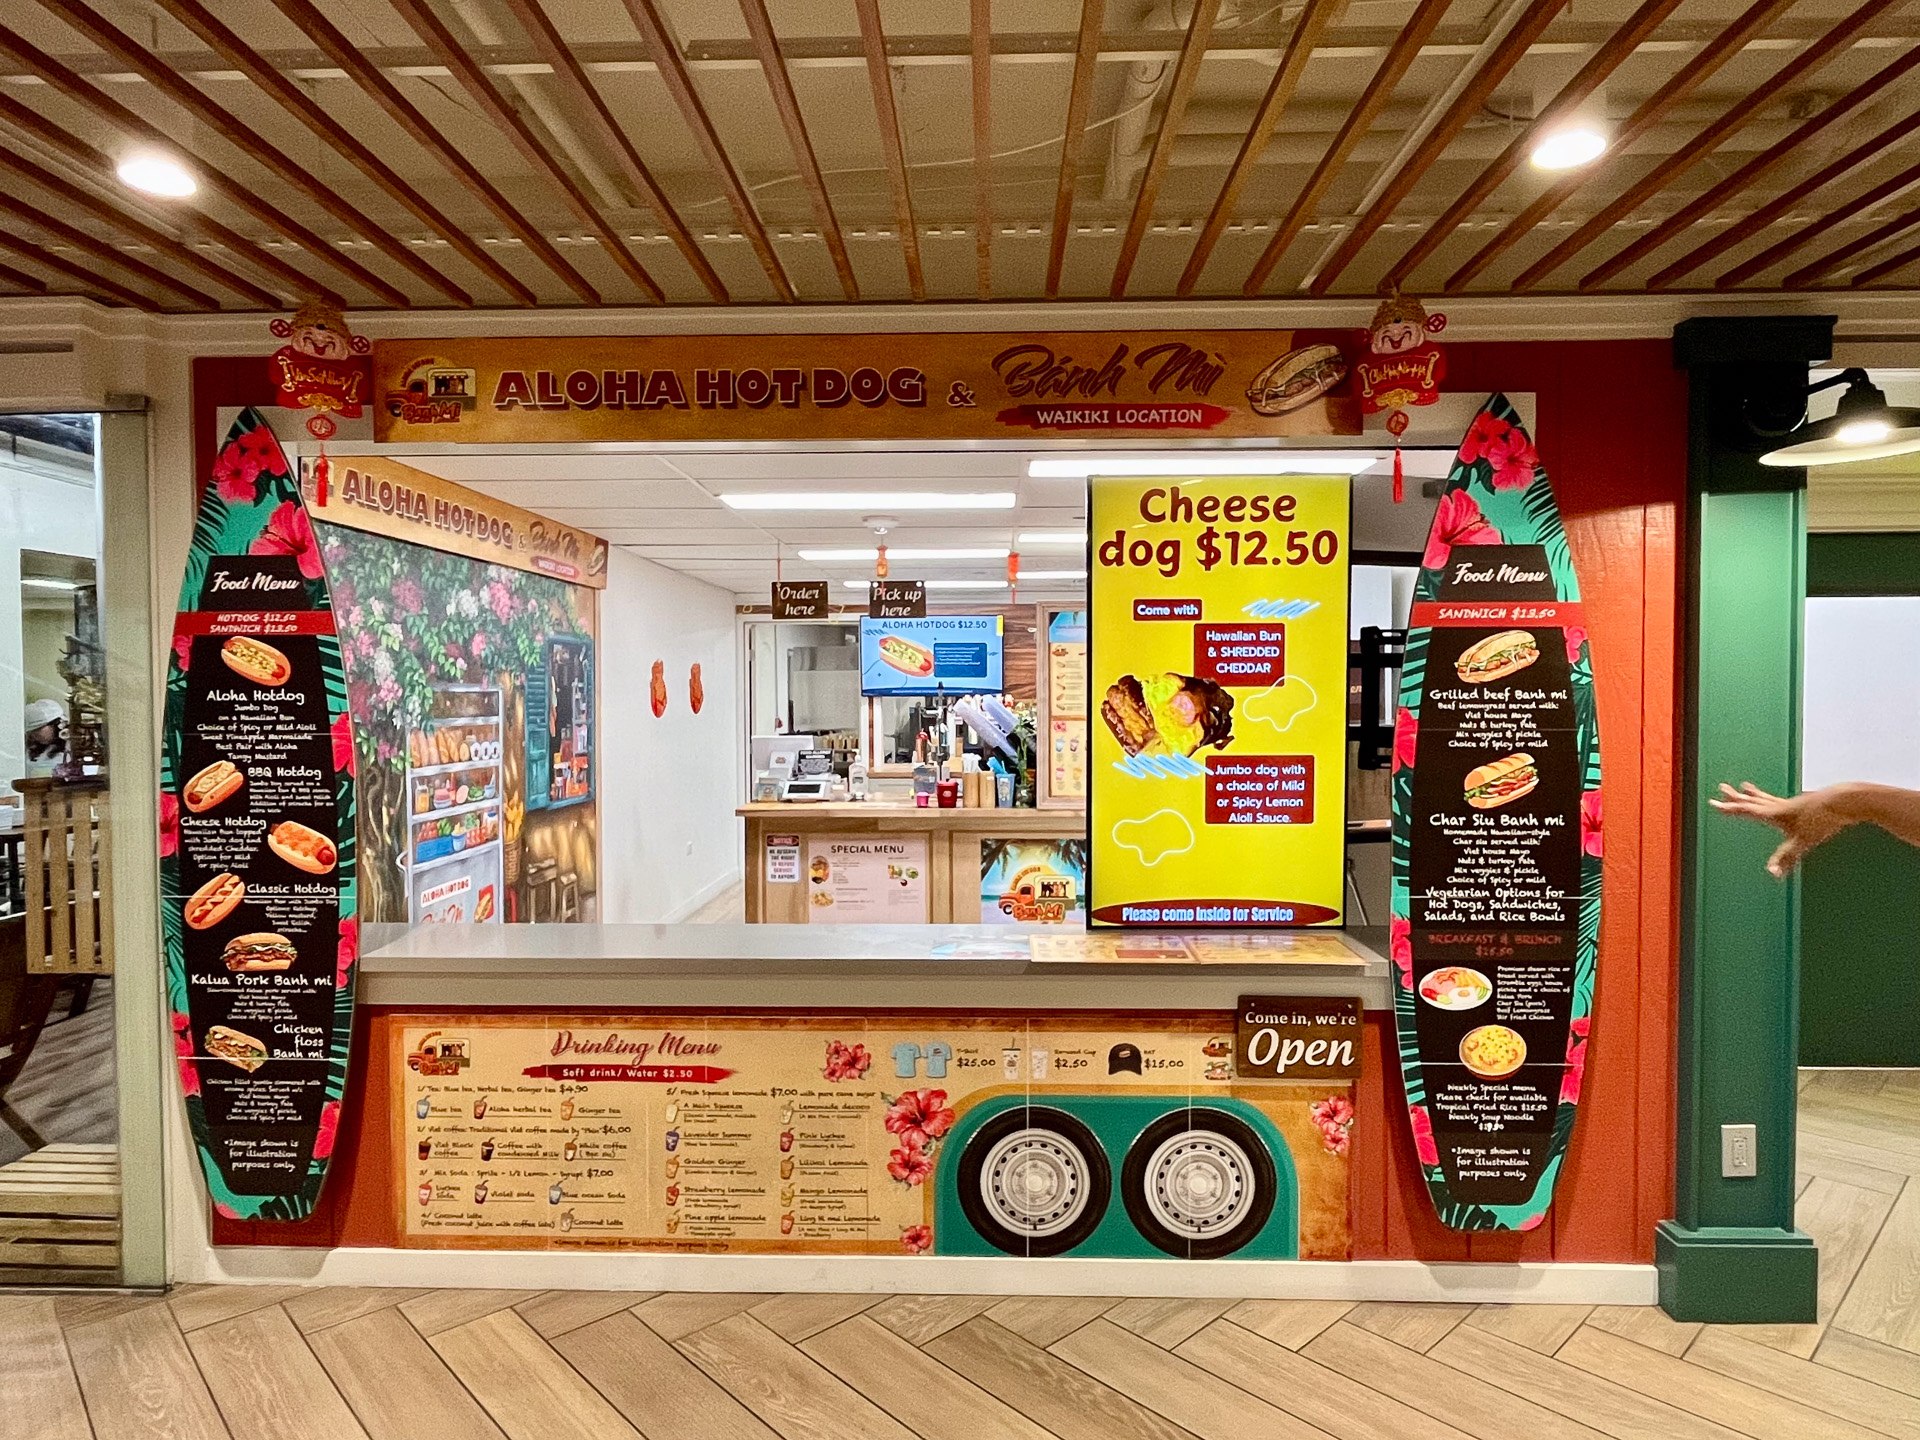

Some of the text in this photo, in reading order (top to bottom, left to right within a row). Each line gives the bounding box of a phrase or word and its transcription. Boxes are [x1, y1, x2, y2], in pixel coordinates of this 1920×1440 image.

[992, 343, 1129, 398] Bánh
[492, 368, 976, 410] ALOHA HOT DOG &
[1037, 410, 1202, 423] WAIKIKI LOCATION
[341, 468, 432, 527] ALOHA
[433, 497, 474, 538] HOT
[476, 514, 514, 549] DOG
[518, 534, 526, 548] &
[1140, 486, 1297, 523] Cheese
[1099, 526, 1338, 577] dog $12.50
[1452, 562, 1548, 584] Food Menu
[211, 571, 300, 592] Food Menu
[780, 587, 819, 600] Order
[873, 589, 921, 602] Pick up
[785, 604, 815, 615] here
[881, 605, 910, 616] here
[1137, 604, 1198, 615] Come with
[1439, 608, 1506, 619] SANDWICH
[217, 614, 260, 622] HOTDOG
[210, 625, 260, 633] SANDWICH
[958, 620, 987, 628] $12.50
[1206, 631, 1281, 641] Hawaiian Bun
[1208, 647, 1280, 657] & SHREDDED
[1216, 663, 1271, 673] CHEDDAR
[206, 689, 304, 705] Aloha Hotdog
[1430, 687, 1567, 700] Grilled beef Banh mi
[228, 723, 236, 732] of
[240, 723, 260, 734] Spicy
[1479, 740, 1489, 748] of
[248, 766, 322, 780] BBQ Hotdog
[1215, 764, 1305, 778] Jumbo dog with
[1216, 780, 1305, 791] a choice of Mild
[1216, 797, 1303, 809] or Spicy Lemon
[181, 817, 267, 829] Cheese Hotdog
[1229, 813, 1291, 823] Aioli Sauce.
[1430, 814, 1565, 826] Char Siu Banh mi
[831, 845, 904, 853] SPECIAL MENU
[247, 884, 336, 896] Classic Hotdog
[1426, 886, 1565, 900] Vegetarian Options for
[1429, 900, 1561, 912] Hot Dogs, Sandwiches,
[1122, 907, 1293, 921] Please come inside for Service
[1424, 912, 1565, 922] Salads, and Rice Bowls
[1428, 934, 1495, 944] BREAKFAST
[1515, 934, 1562, 944] BRUNCH
[192, 974, 332, 986] Kalua Pork Banh mi
[1246, 1012, 1357, 1026] Come in, we're
[274, 1024, 323, 1034] Chicken
[294, 1034, 324, 1048] floss
[273, 1049, 324, 1059] Banh mi
[551, 1031, 722, 1067] Drinking Menu
[1247, 1028, 1355, 1074] Open
[957, 1057, 996, 1069] $25.00
[1054, 1058, 1088, 1069] $2.50
[1144, 1058, 1184, 1069] $15.00
[563, 1068, 693, 1079] Soft drink/ Water $2.50
[771, 1088, 798, 1098] $7.00
[1436, 1103, 1470, 1113] Tropical
[1473, 1103, 1497, 1111] Fried
[602, 1125, 631, 1135] $6.00
[261, 1139, 287, 1147] shown
[230, 1150, 297, 1159] for illustration
[1490, 1147, 1519, 1155] shown
[232, 1161, 295, 1172] purposes only
[1457, 1157, 1529, 1167] for illustration
[587, 1169, 614, 1179] $7.00
[1459, 1169, 1527, 1180] purposes only
